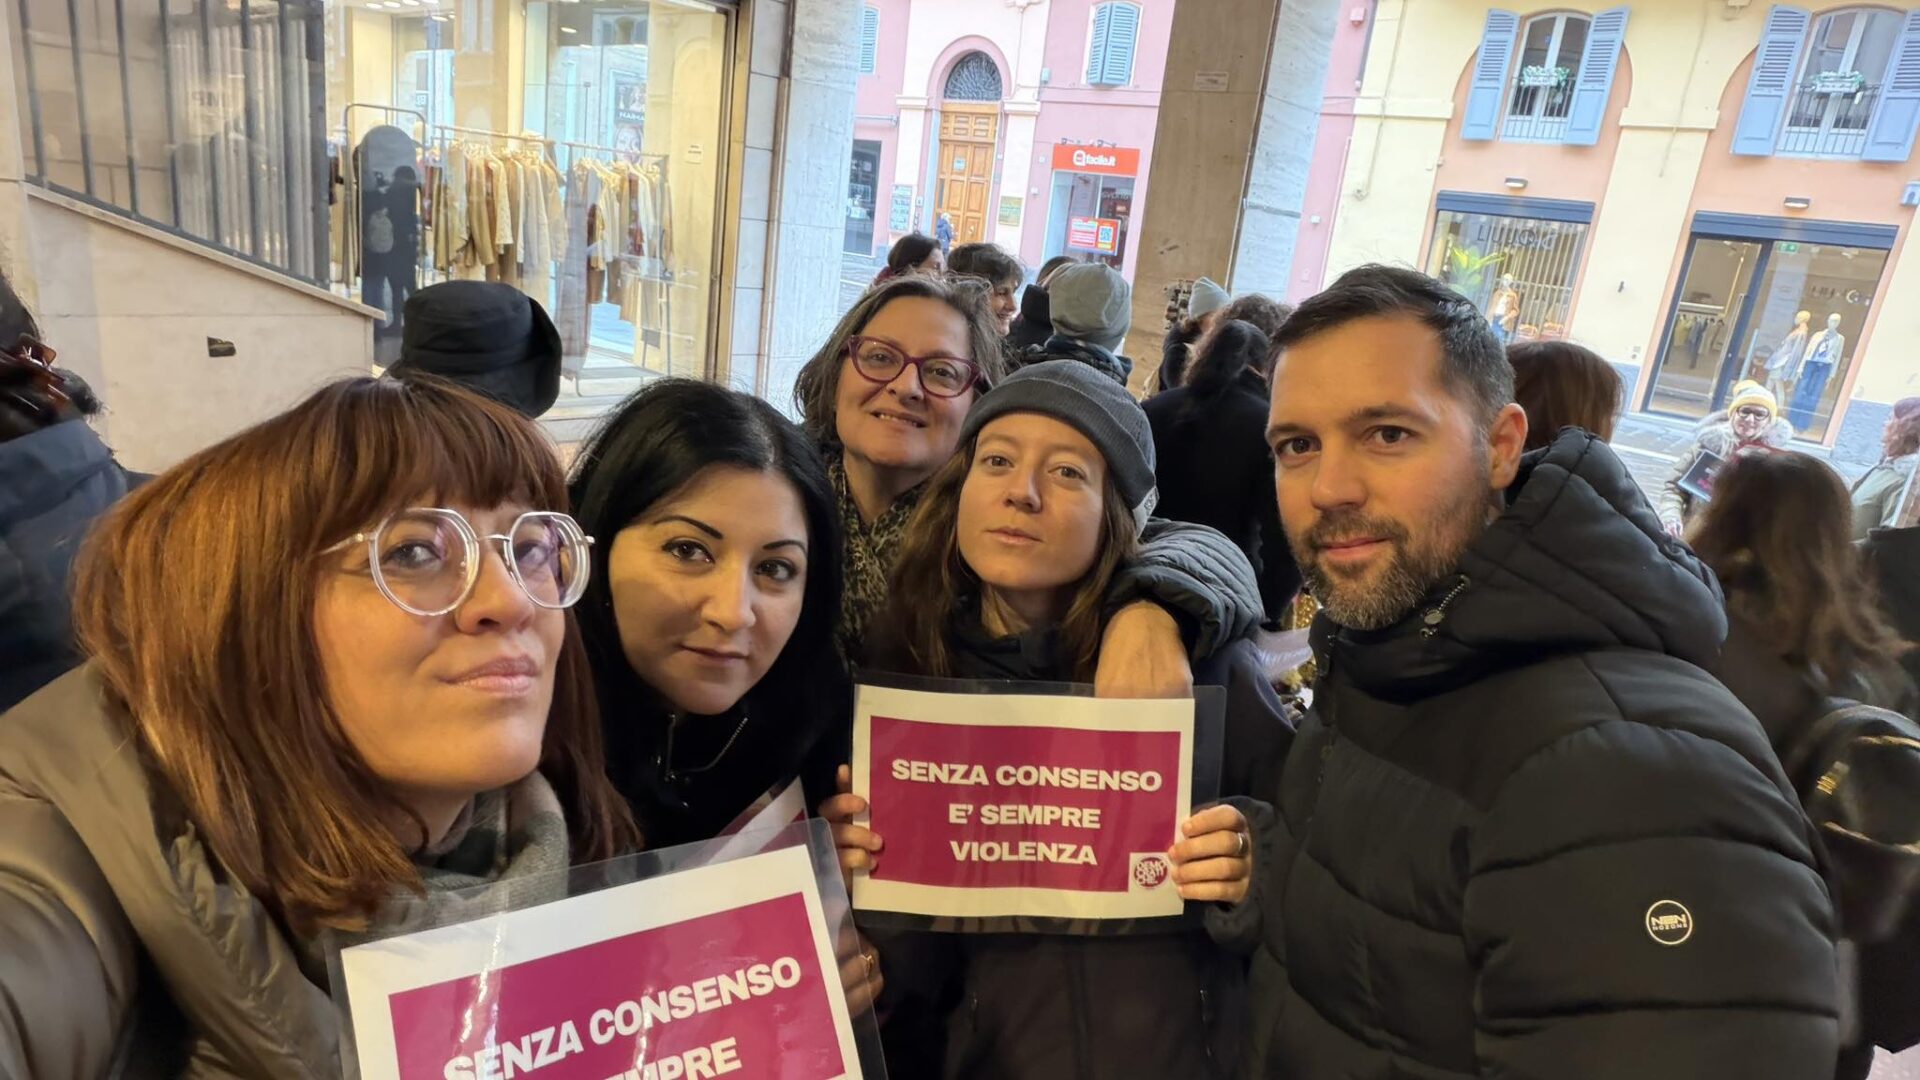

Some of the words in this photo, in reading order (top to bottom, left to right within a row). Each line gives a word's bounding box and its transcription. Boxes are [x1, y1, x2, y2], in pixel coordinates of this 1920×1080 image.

[891, 759, 989, 786] SENZA
[996, 765, 1162, 792] CONSENSO
[980, 804, 1101, 829] SEMPRE
[950, 840, 1098, 866] VIOLENZA
[444, 1020, 584, 1080] SENZA
[590, 957, 801, 1045] CONSENSO
